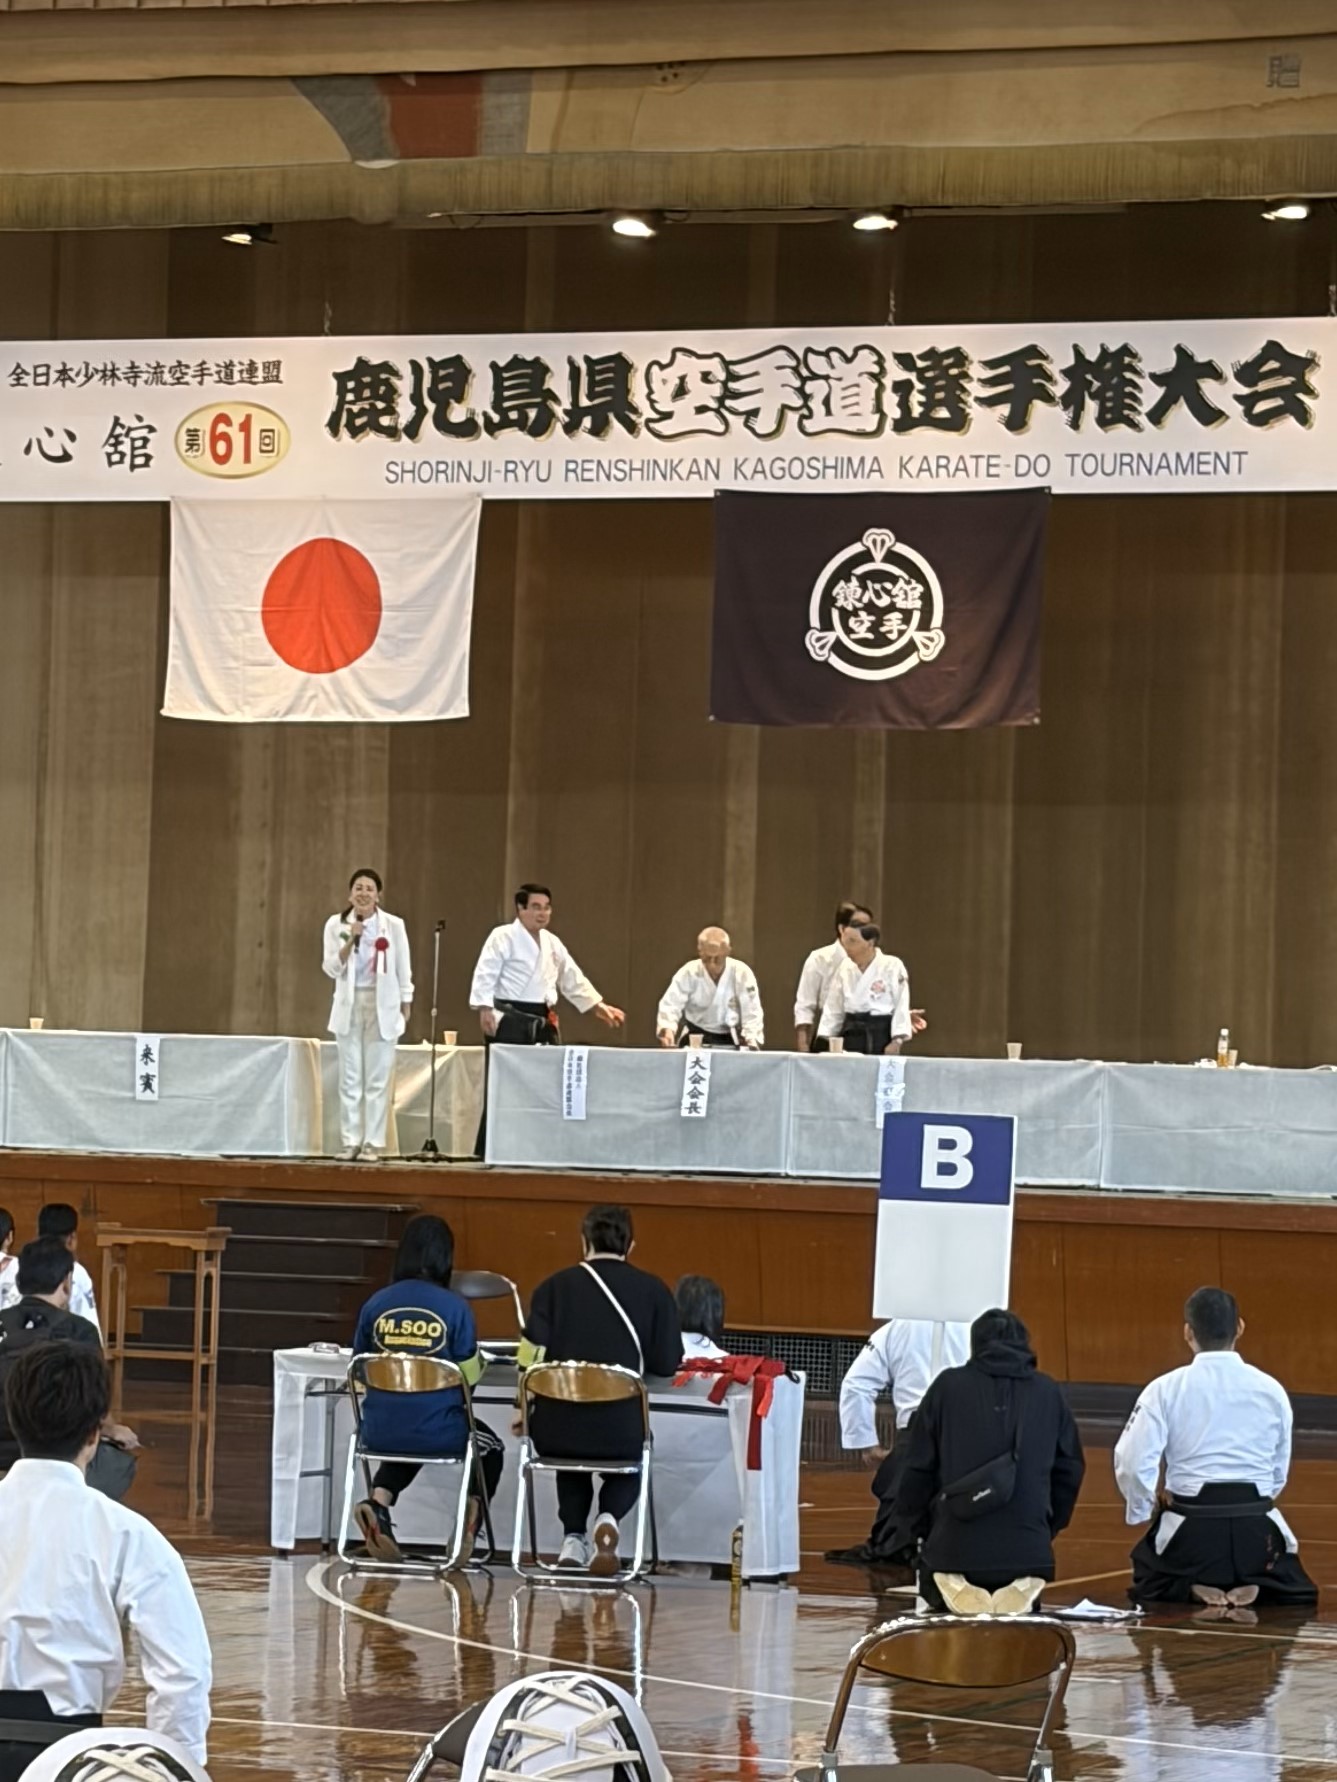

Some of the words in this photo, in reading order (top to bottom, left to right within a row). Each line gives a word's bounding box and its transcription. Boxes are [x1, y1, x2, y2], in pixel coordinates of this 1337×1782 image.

[8, 359, 284, 388] 全日本少林寺流空手道連盟
[324, 339, 1322, 443] 鹿児島県空手道選手権大会
[184, 412, 279, 466] 第61回
[385, 460, 552, 484] SHORINJI-RYU
[564, 458, 721, 482] RENSHINKAN
[733, 456, 885, 481] KAGOSHIMA
[898, 454, 1051, 479] KARATE-DO
[1064, 451, 1249, 477] TOURNAMENT
[848, 611, 908, 640] 空手
[684, 1056, 707, 1114] 大会会長
[921, 1124, 974, 1189] B
[379, 1318, 442, 1338] M.SOO
